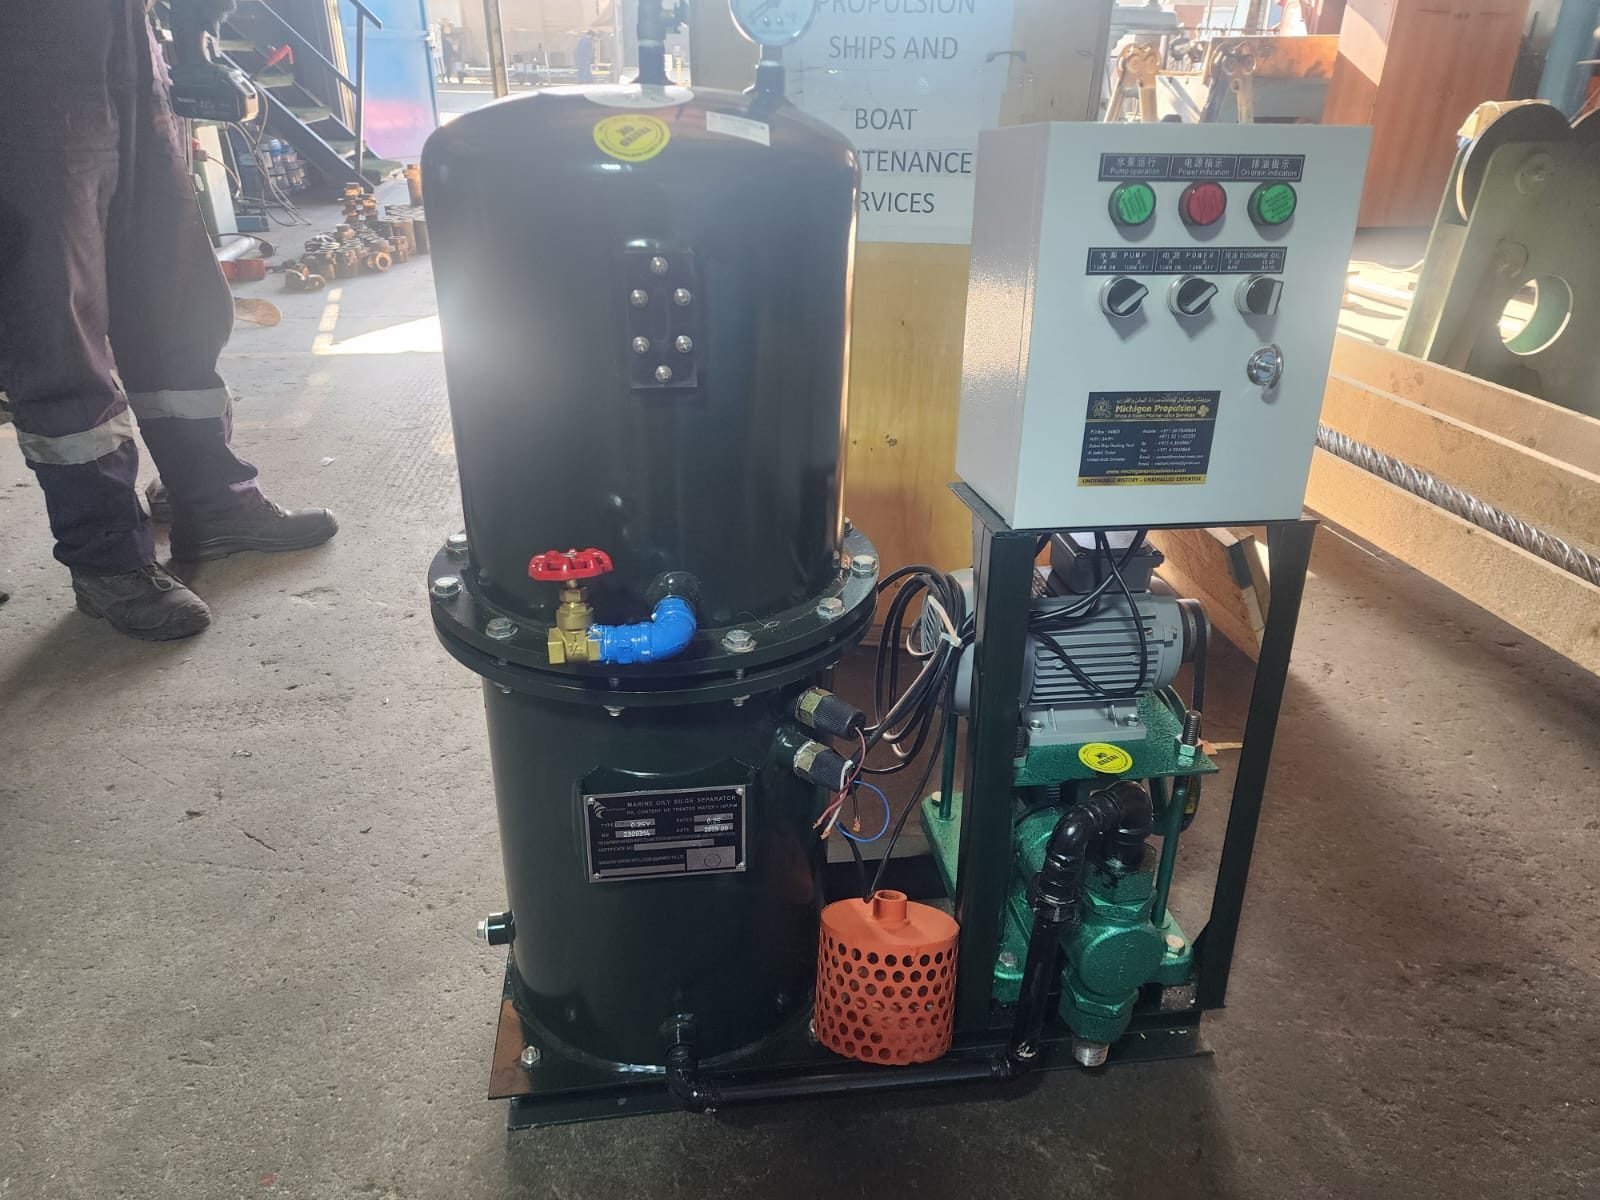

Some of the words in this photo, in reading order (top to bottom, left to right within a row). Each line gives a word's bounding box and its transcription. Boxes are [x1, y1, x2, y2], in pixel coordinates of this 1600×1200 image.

[828, 35, 896, 60] SHIPS
[903, 36, 958, 60] AND
[855, 108, 918, 131] BOAT
[857, 150, 973, 173] TENANCE
[1115, 404, 1152, 414] Michigan
[1154, 404, 1197, 414] Propulsion
[627, 800, 653, 808] MARINE
[697, 795, 736, 803] SEPARATOR
